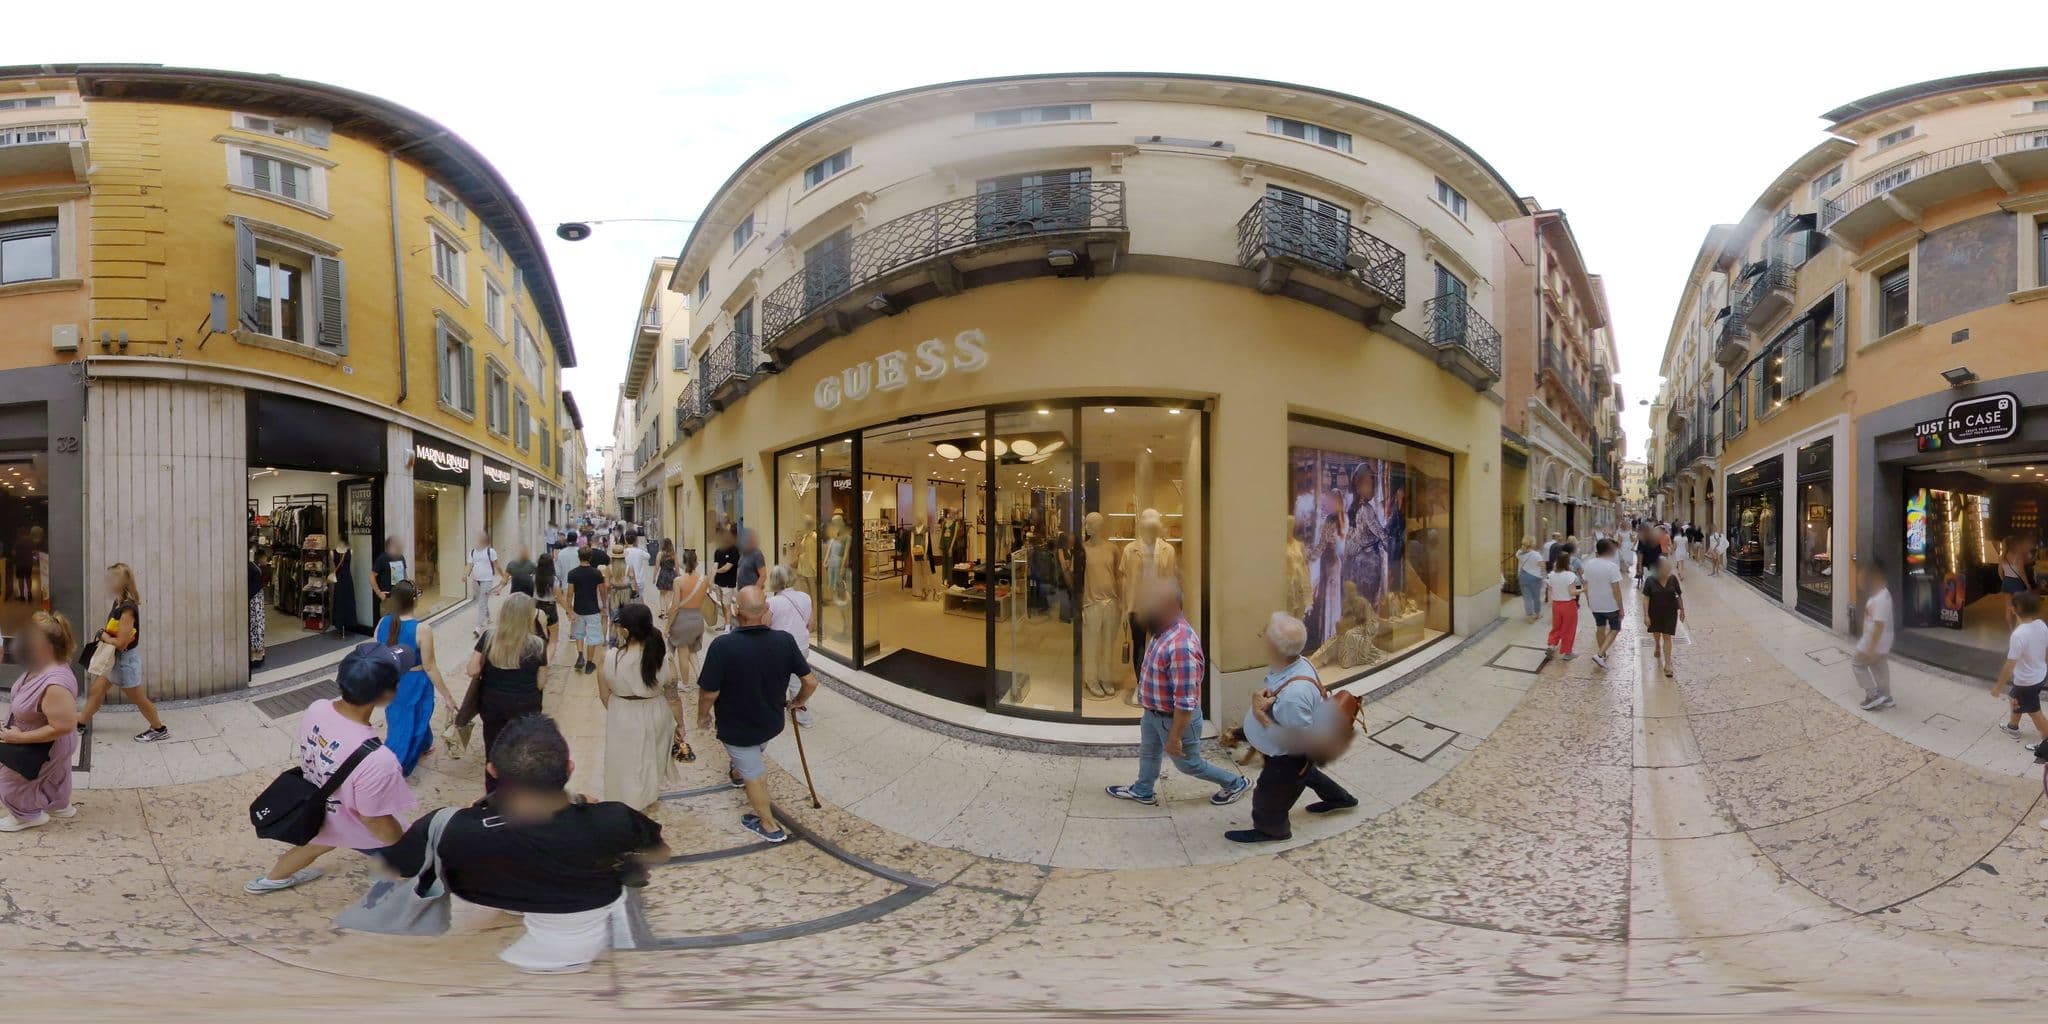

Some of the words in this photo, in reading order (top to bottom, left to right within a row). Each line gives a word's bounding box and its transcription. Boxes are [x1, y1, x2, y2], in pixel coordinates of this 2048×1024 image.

[813, 328, 988, 410] GUESS
[1915, 420, 1944, 436] JUST
[1948, 419, 1960, 430] in
[1965, 411, 2001, 427] CASE
[57, 436, 79, 453] 32
[416, 444, 446, 466] MARINA
[446, 453, 469, 470] RINALDI
